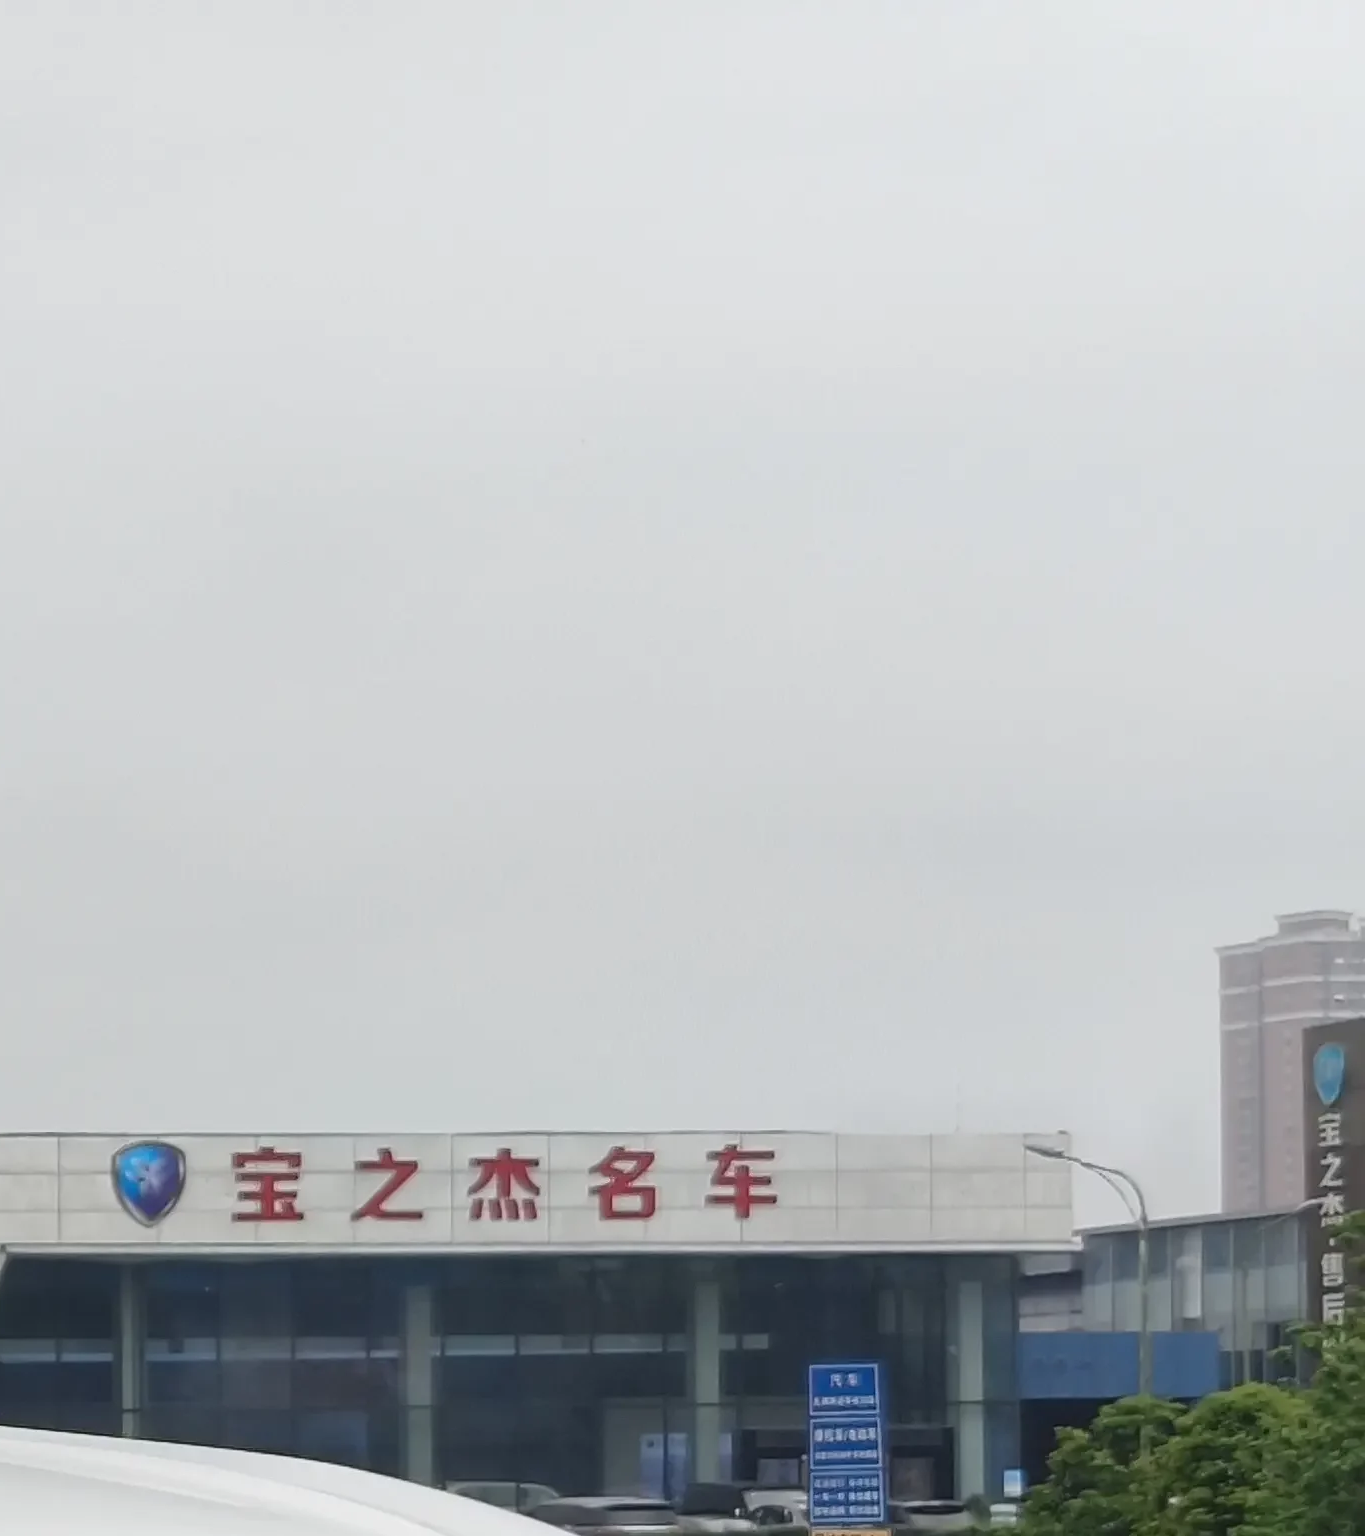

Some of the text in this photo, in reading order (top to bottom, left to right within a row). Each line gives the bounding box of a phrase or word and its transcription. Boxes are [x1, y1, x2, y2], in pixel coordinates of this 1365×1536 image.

[230, 1145, 778, 1223] 宝之杰名车
[1318, 1112, 1345, 1360] 宝之杰·售后
